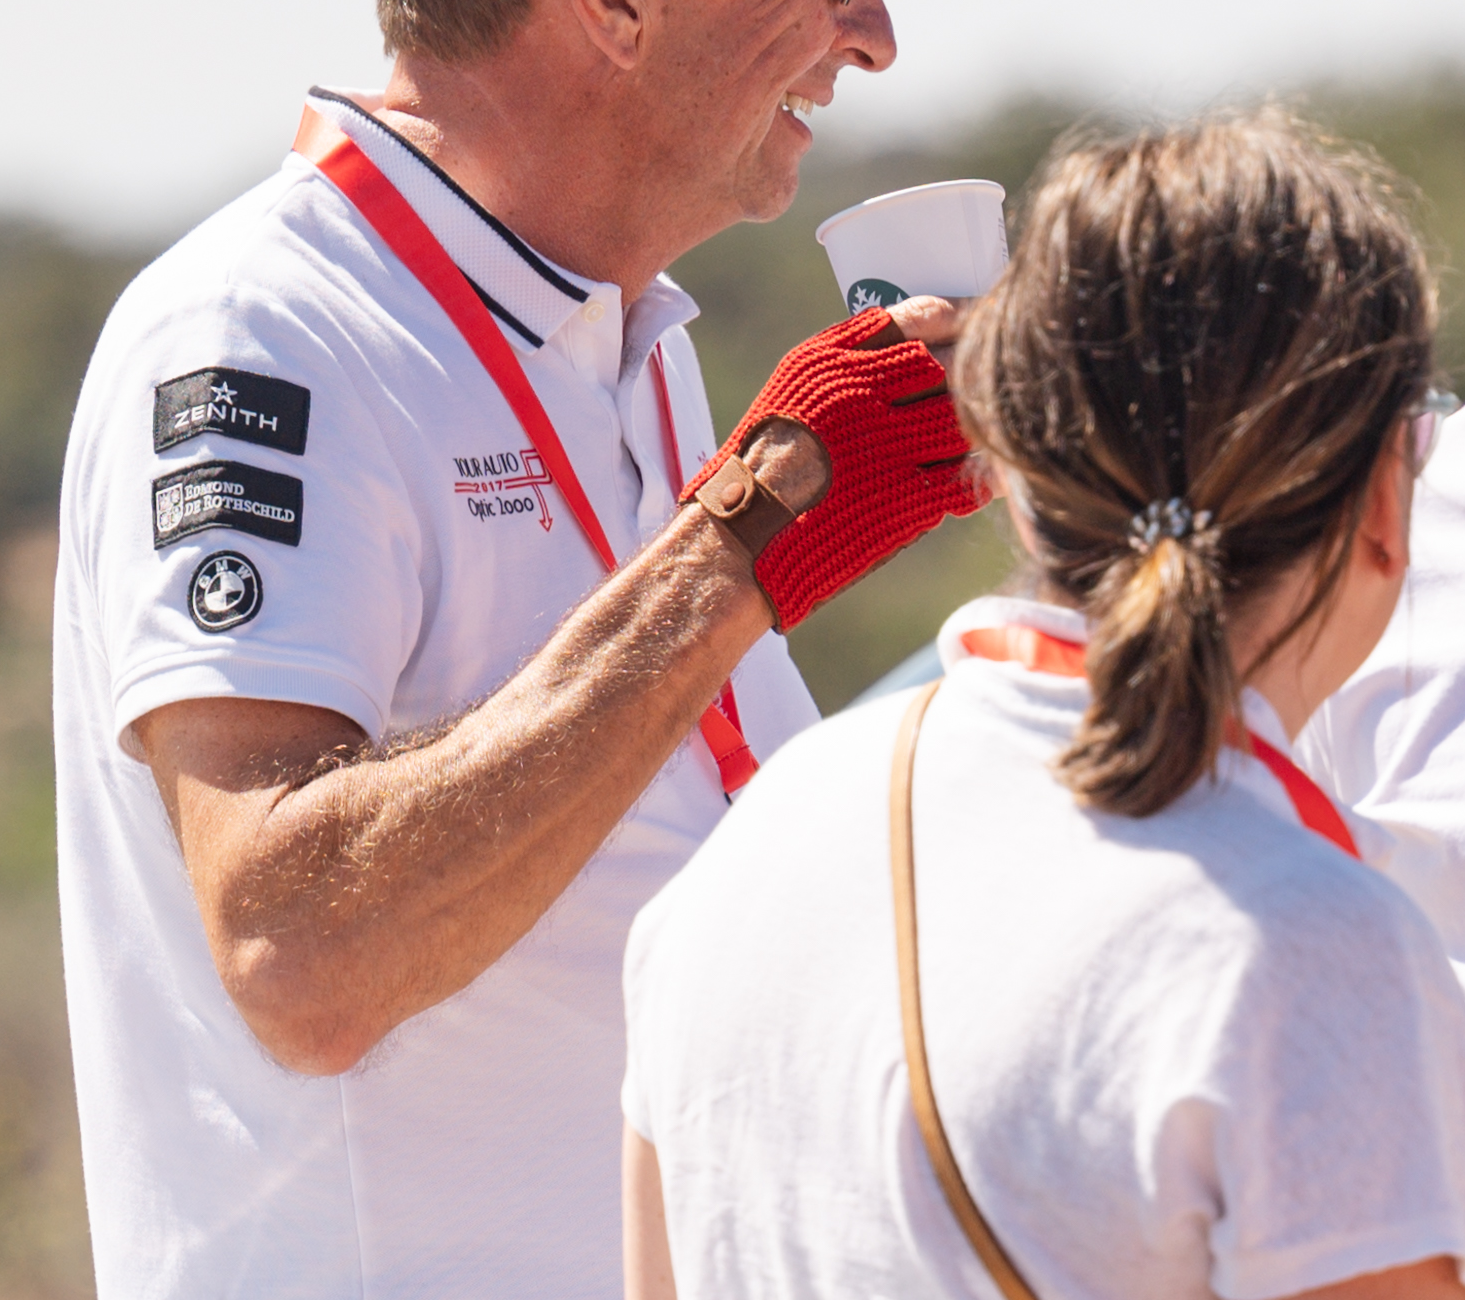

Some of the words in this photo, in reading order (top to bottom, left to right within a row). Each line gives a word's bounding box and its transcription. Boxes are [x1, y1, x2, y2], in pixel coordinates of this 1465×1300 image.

[174, 402, 278, 432] ZENITH
[483, 452, 519, 476] AUTO
[185, 480, 245, 500] EDMOND
[475, 480, 503, 493] 2017
[185, 499, 201, 517] DE
[203, 495, 295, 523] ROTHSCHILD
[467, 496, 497, 522] Optic
[496, 496, 535, 516] 2000
[198, 558, 252, 589] BMW
